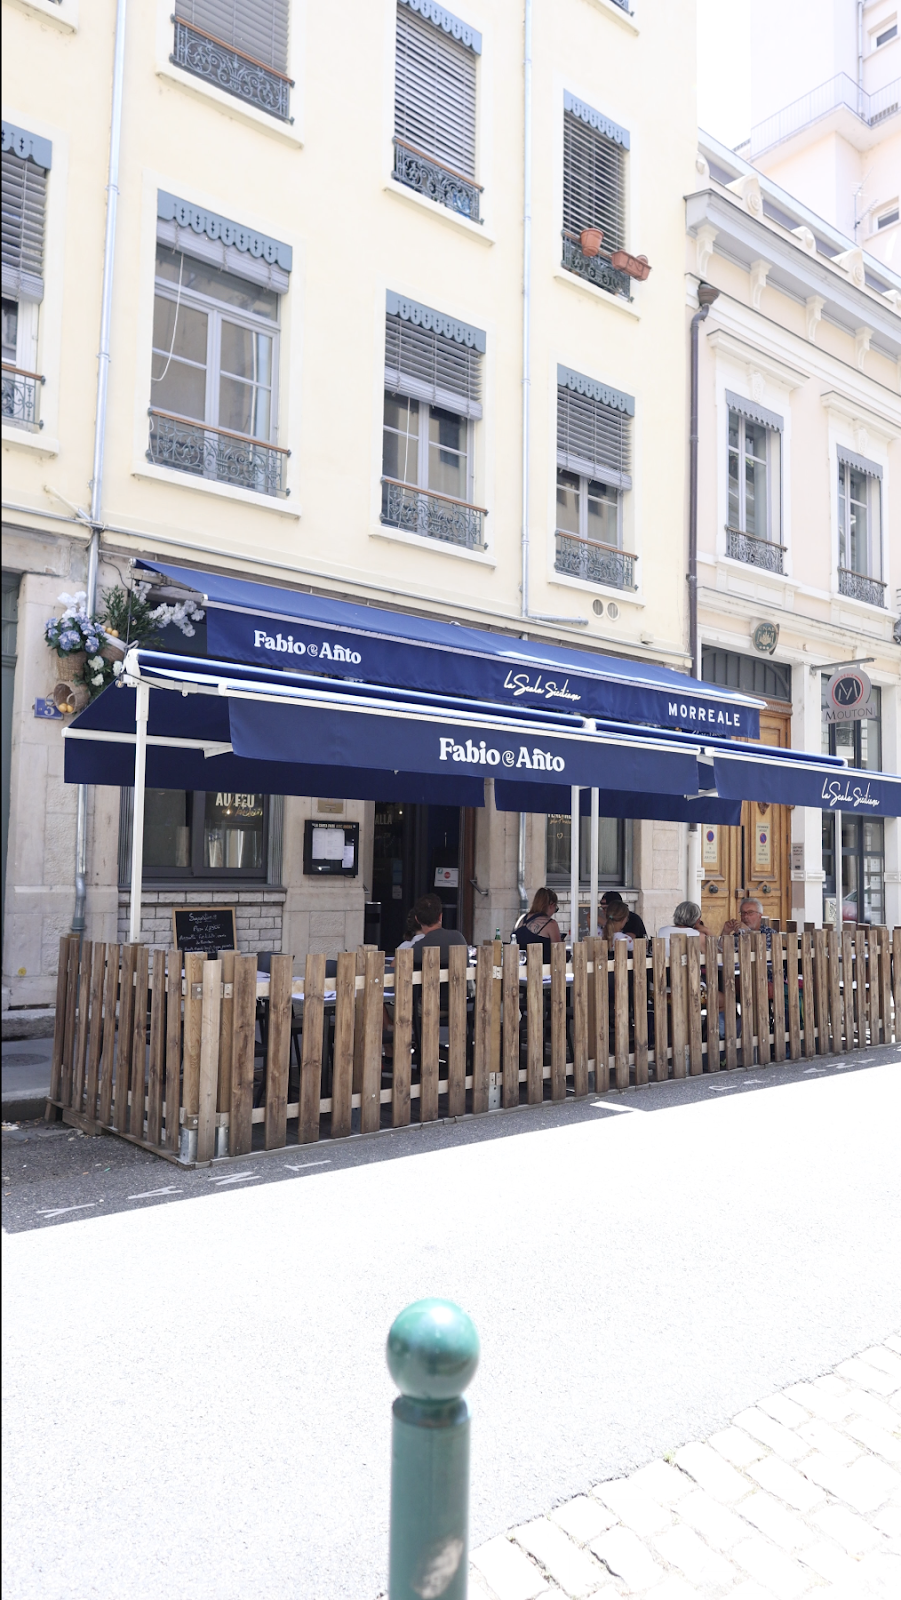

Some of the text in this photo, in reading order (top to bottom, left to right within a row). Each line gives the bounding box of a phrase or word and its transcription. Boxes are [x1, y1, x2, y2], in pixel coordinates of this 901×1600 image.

[253, 630, 306, 655] Fabio
[307, 643, 318, 657] e
[512, 673, 545, 696] Scala
[544, 678, 582, 702] Siciliana
[668, 701, 741, 727] MORREALE
[439, 737, 502, 765] Fabio
[502, 751, 516, 767] e
[215, 792, 231, 806] AU
[828, 780, 854, 807] Scala
[853, 781, 881, 808] Siciliana
